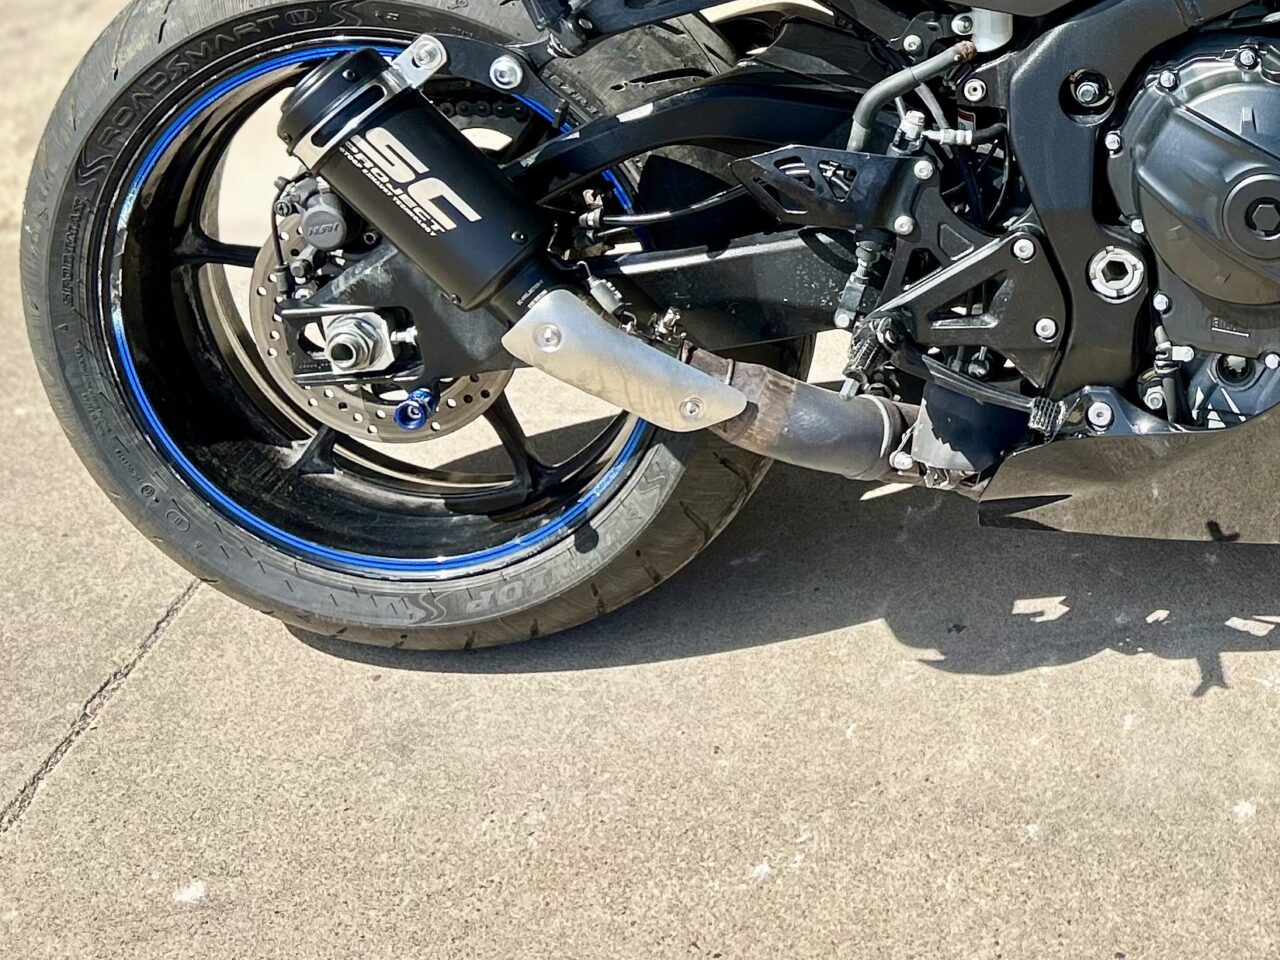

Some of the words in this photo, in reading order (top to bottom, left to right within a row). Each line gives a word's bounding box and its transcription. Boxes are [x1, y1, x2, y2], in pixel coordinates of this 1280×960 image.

[101, 13, 280, 152] ROADSMART
[345, 141, 445, 233] PROJECT
[350, 126, 482, 231] SC
